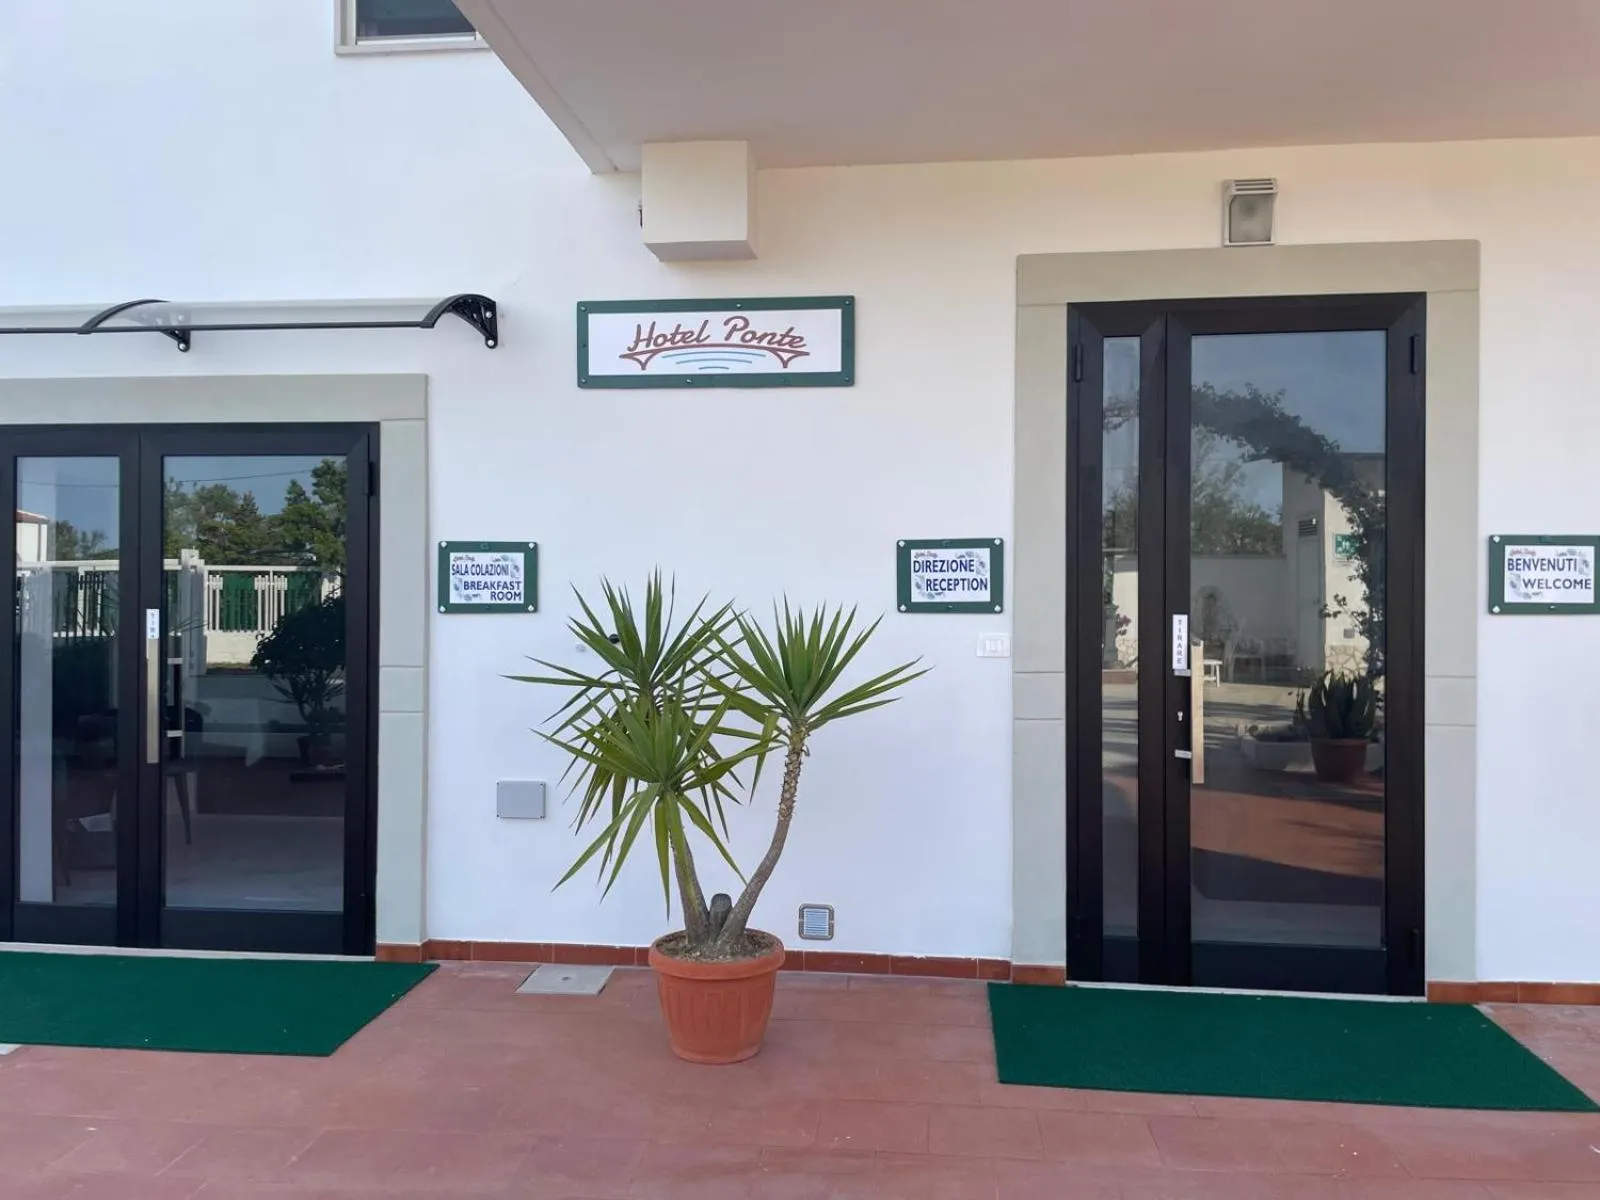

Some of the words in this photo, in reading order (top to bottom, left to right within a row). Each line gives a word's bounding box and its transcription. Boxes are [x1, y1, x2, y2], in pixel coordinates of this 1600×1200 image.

[627, 320, 710, 352] Hotel
[723, 315, 807, 349] Ponte
[451, 564, 469, 576] SALA
[470, 564, 509, 576] COLAZIONI
[913, 559, 975, 573] DIREZIONE
[1507, 558, 1577, 572] BENVENUTI
[463, 580, 522, 591] BREAKFAST
[926, 578, 988, 592] RECEPTION
[1522, 578, 1592, 590] WELCOME
[490, 591, 522, 601] ROOM
